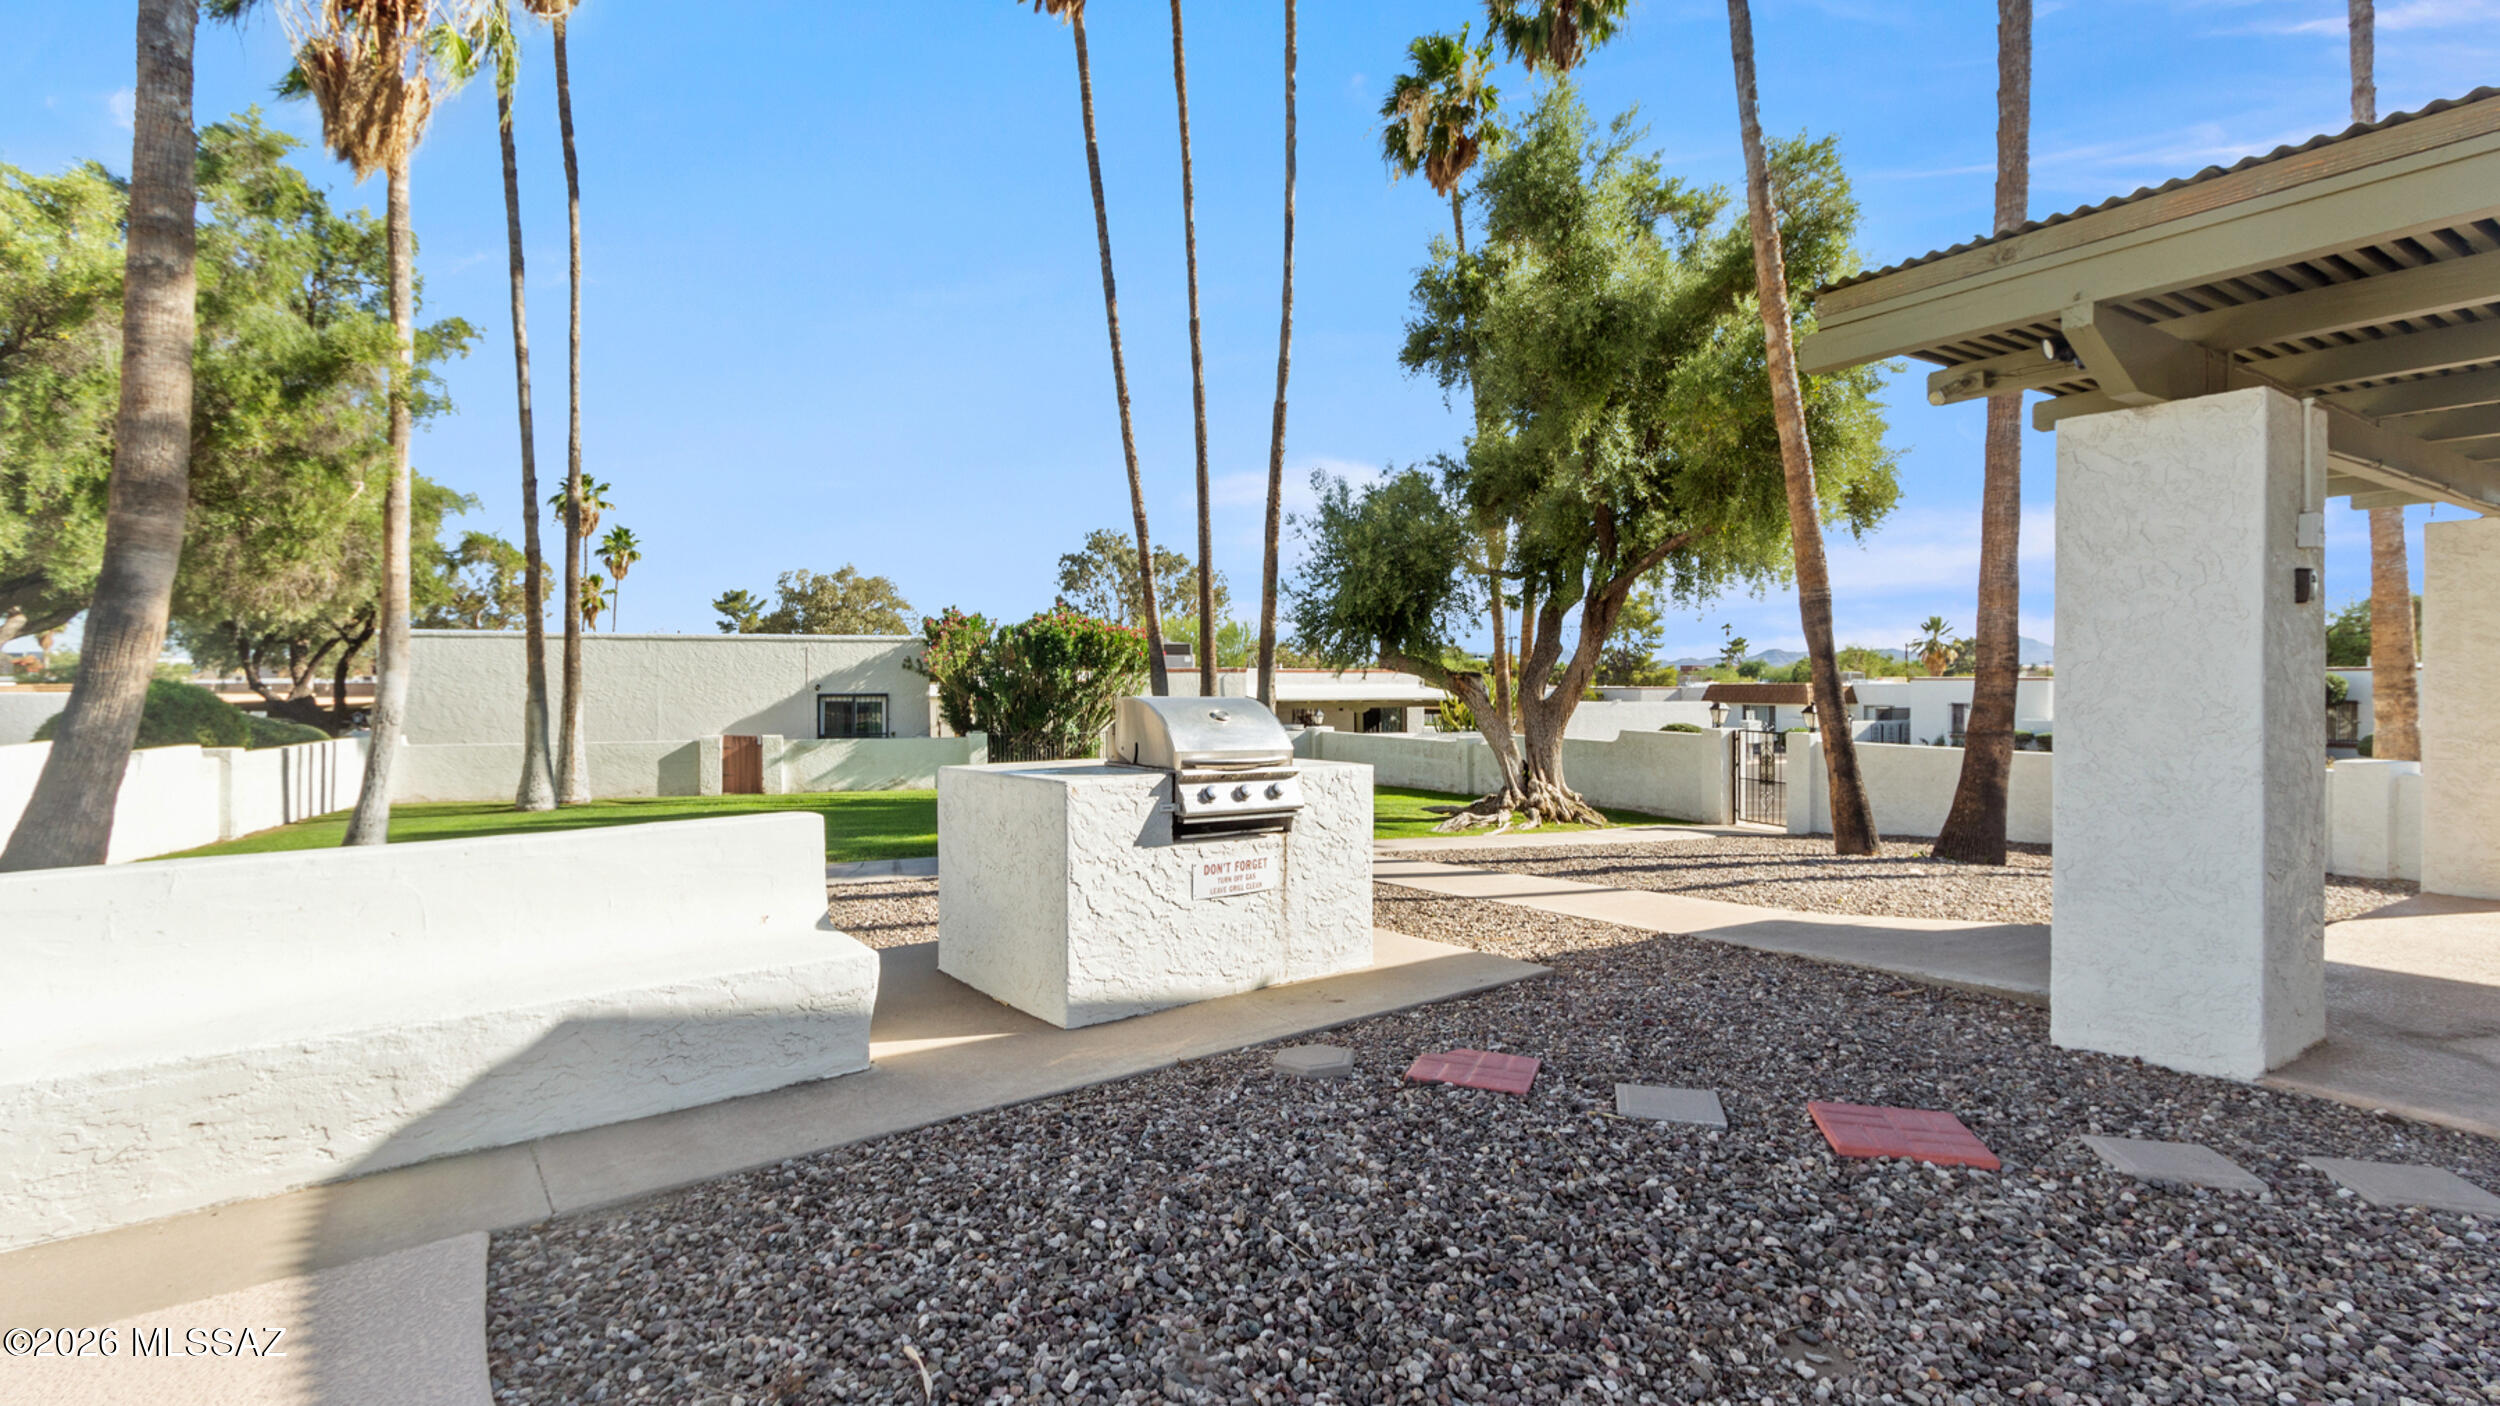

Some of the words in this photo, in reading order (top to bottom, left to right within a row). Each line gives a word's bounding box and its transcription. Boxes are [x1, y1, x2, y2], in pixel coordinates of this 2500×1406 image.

[1203, 862, 1231, 876] DON'T
[1234, 857, 1268, 872] FORGET
[1217, 876, 1232, 884] TURN
[1233, 874, 1243, 882] OFF
[1245, 873, 1256, 881] GAS
[1210, 886, 1227, 895] LEAVE
[1229, 884, 1244, 892] GRILL
[1246, 882, 1262, 890] CLEAN
